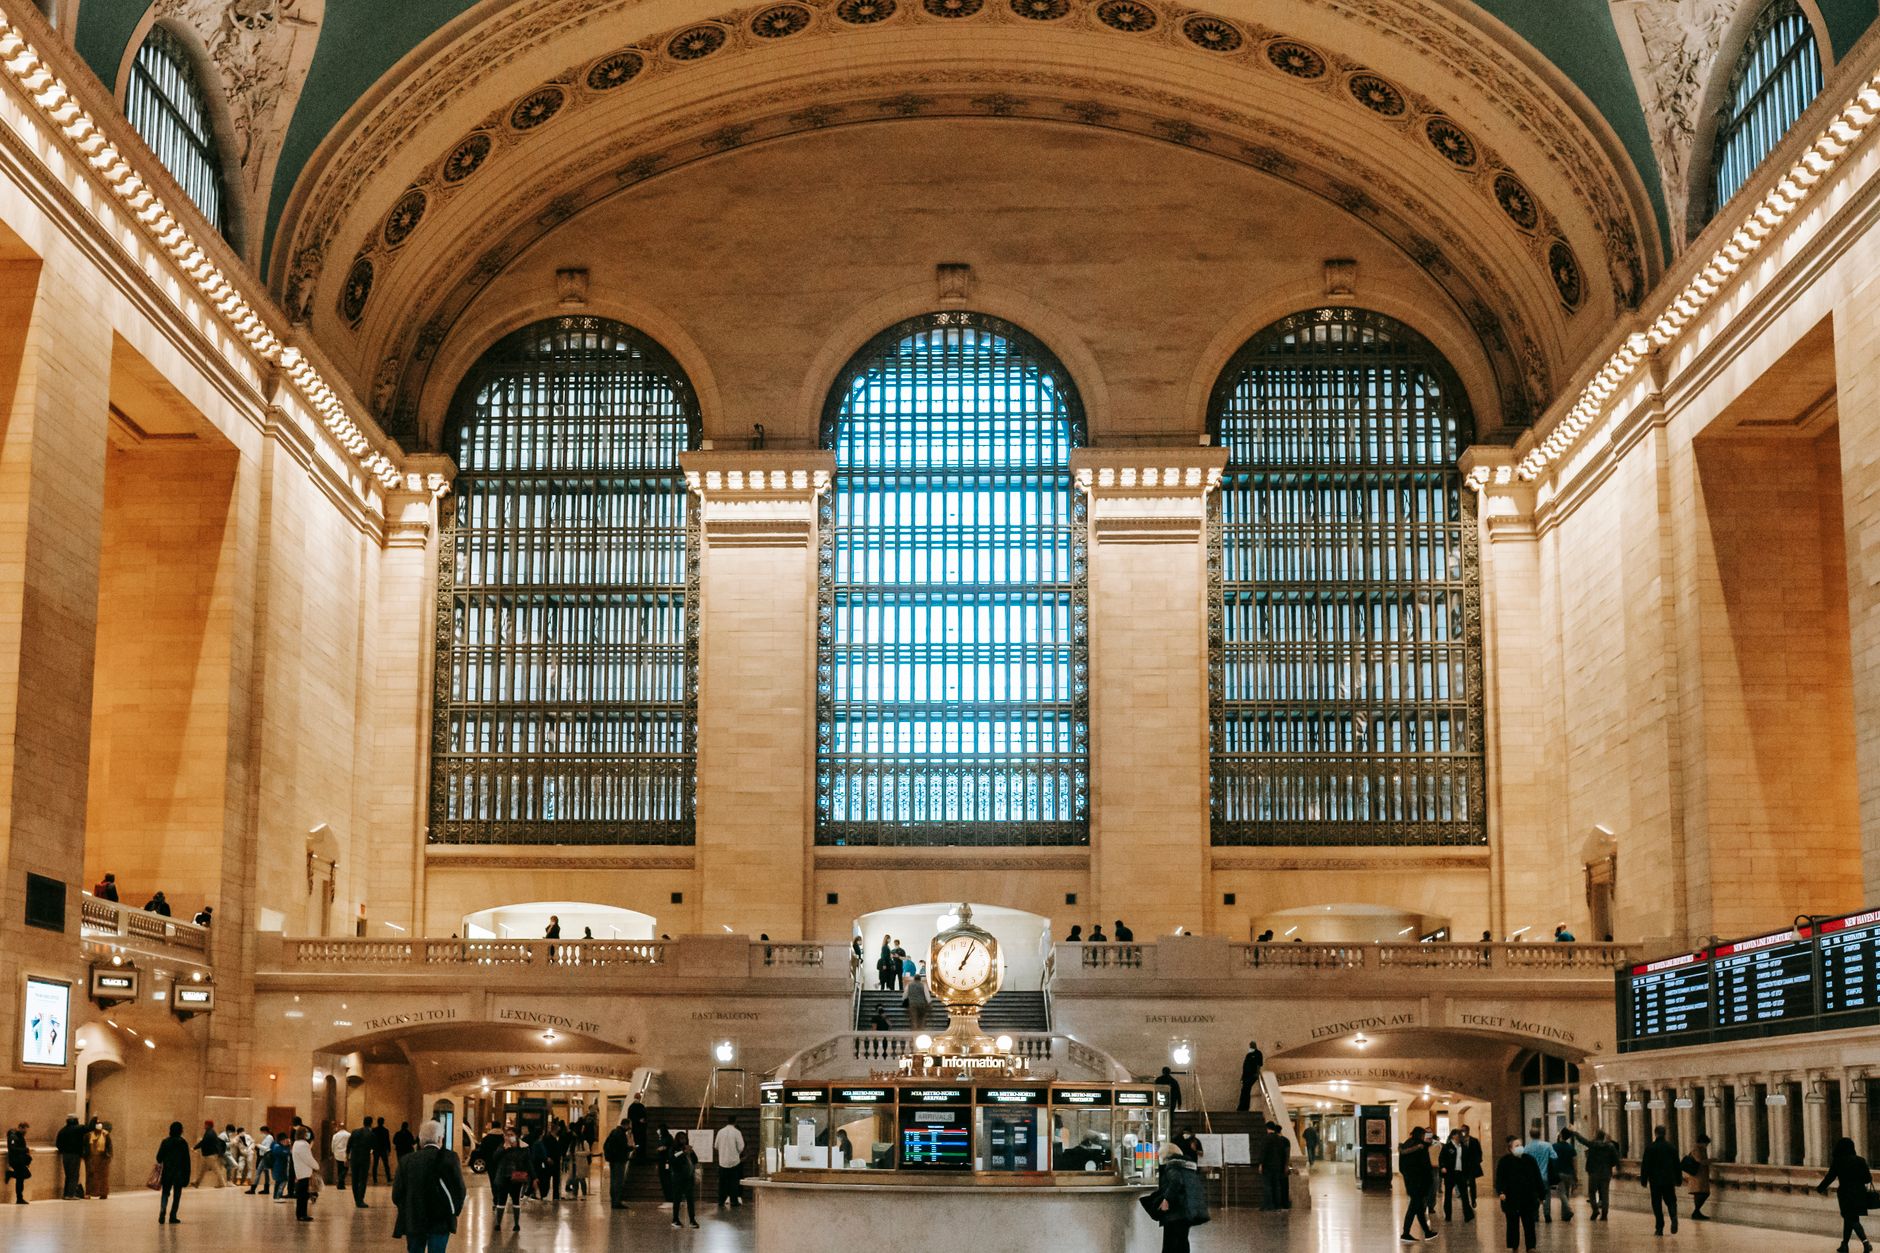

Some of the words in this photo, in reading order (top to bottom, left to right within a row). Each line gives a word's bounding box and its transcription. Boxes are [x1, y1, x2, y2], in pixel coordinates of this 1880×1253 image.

[364, 1014, 410, 1030] TRACKS
[426, 1009, 444, 1020] TO
[500, 1009, 573, 1028] LEXINGTON
[575, 1020, 601, 1034] AVE
[692, 1012, 714, 1020] EAST
[716, 1012, 760, 1020] BALCONY
[1145, 1015, 1170, 1023] EAST
[1171, 1015, 1215, 1023] BALCONY
[1311, 1015, 1387, 1039] LEXINGTON
[1391, 1013, 1415, 1025] AVE
[1461, 1014, 1505, 1027] TICKET
[1509, 1019, 1575, 1042] MACHINES
[514, 1063, 556, 1073] PASSAGE
[941, 1055, 1005, 1068] Information
[1317, 1068, 1363, 1078] PASSAGE
[1368, 1067, 1413, 1080] SUBWAY
